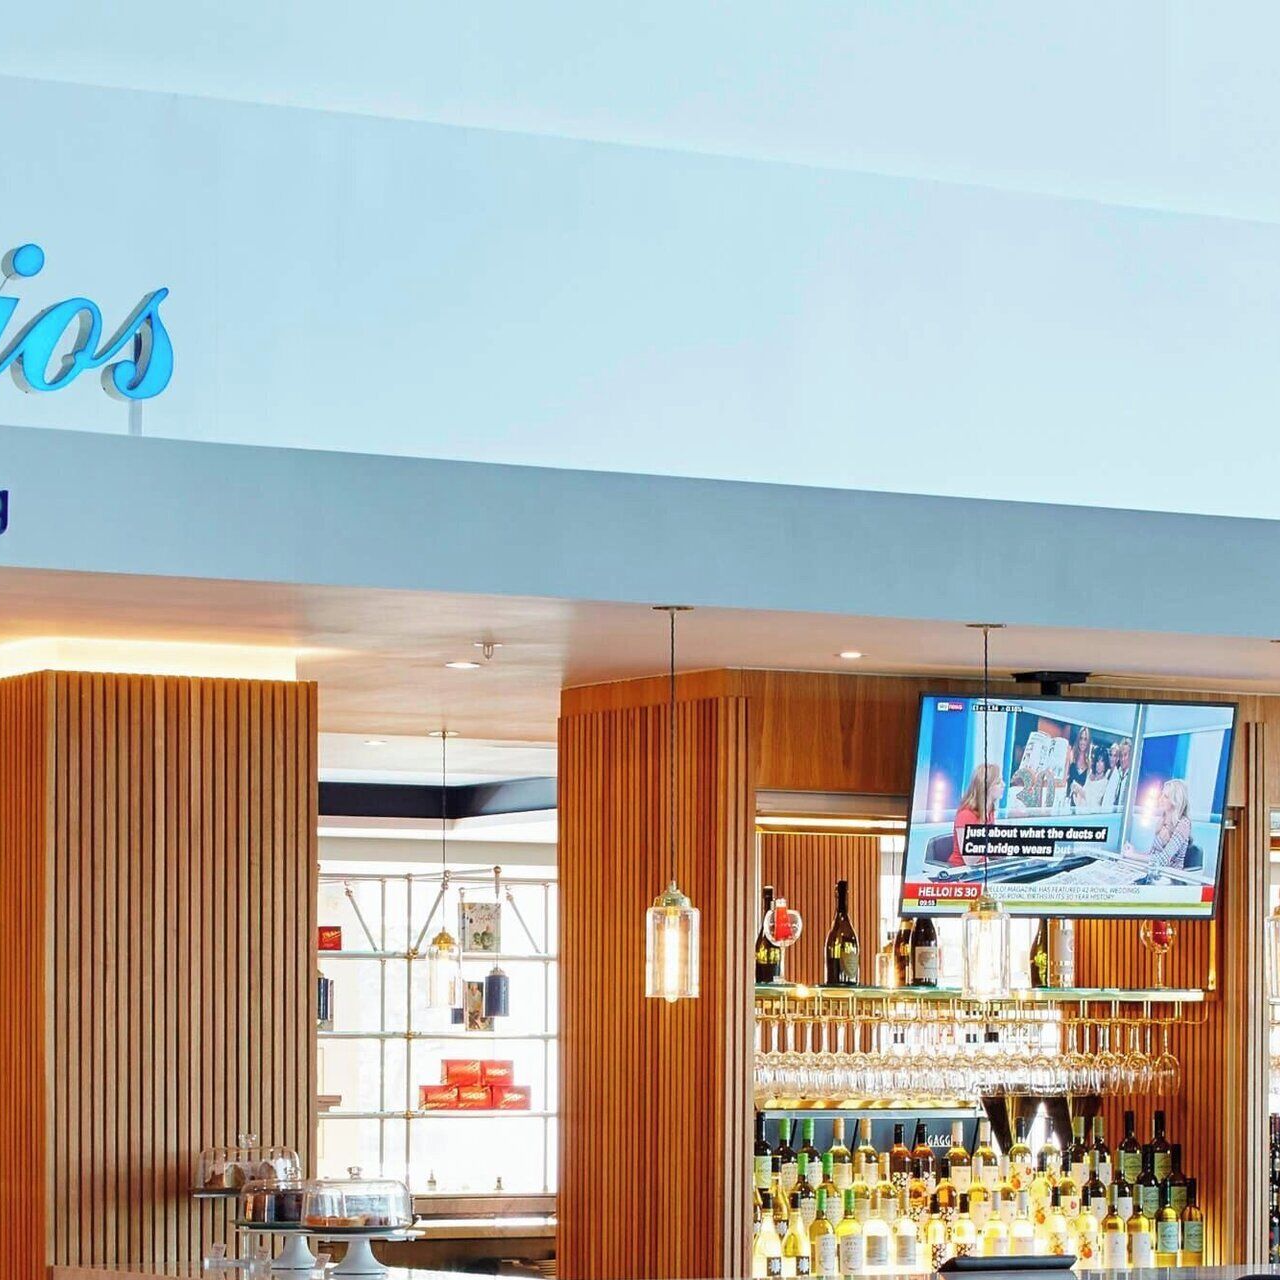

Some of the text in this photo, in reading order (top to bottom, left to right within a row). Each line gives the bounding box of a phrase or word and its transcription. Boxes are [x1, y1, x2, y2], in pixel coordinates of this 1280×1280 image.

[966, 826, 986, 839] just
[988, 827, 1018, 838] about
[1020, 828, 1045, 838] what
[1047, 828, 1064, 838] the
[1095, 829, 1107, 840] of
[1022, 845, 1052, 855] wears
[918, 887, 952, 897] HELLO!
[954, 887, 963, 897] IS
[965, 887, 978, 897] 30
